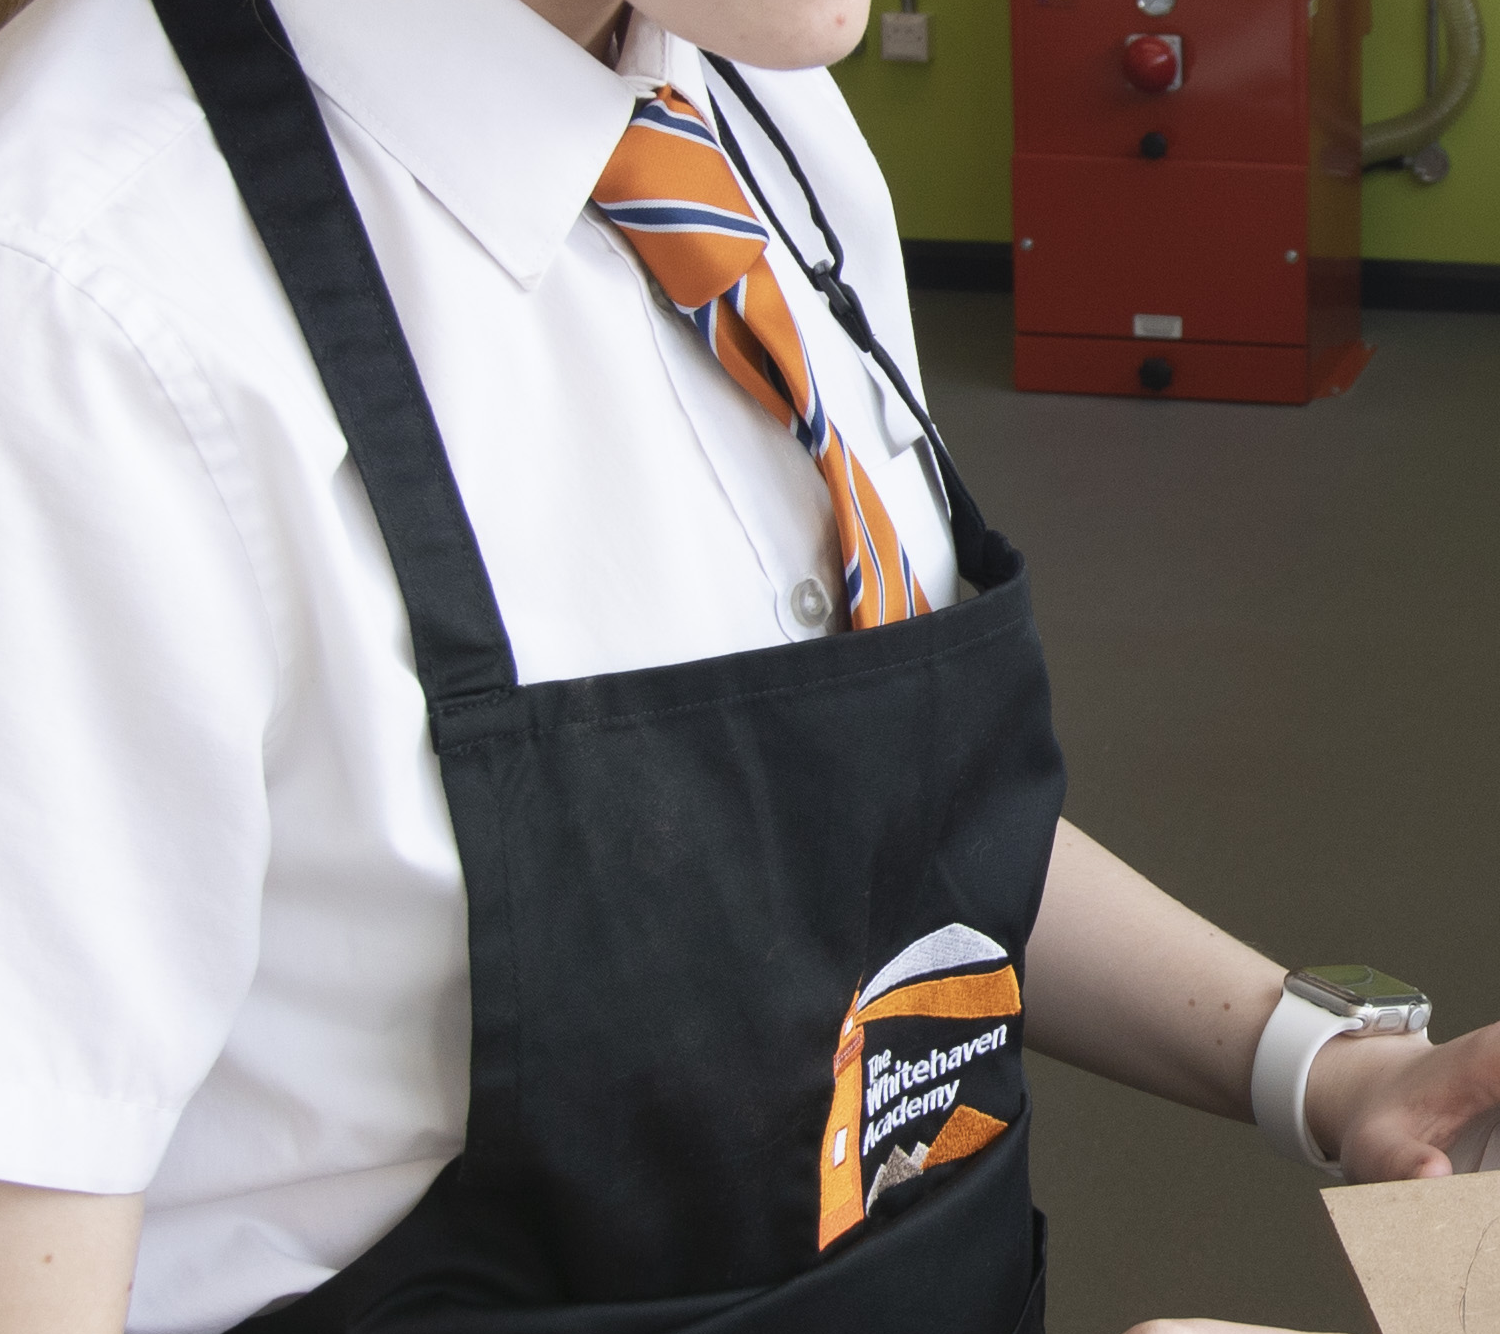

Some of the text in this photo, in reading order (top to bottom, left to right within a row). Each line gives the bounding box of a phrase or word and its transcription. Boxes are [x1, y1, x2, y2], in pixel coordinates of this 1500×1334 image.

[866, 1023, 1008, 1117] Whitehaven
[867, 1047, 892, 1082] The
[863, 1079, 961, 1156] Academy
